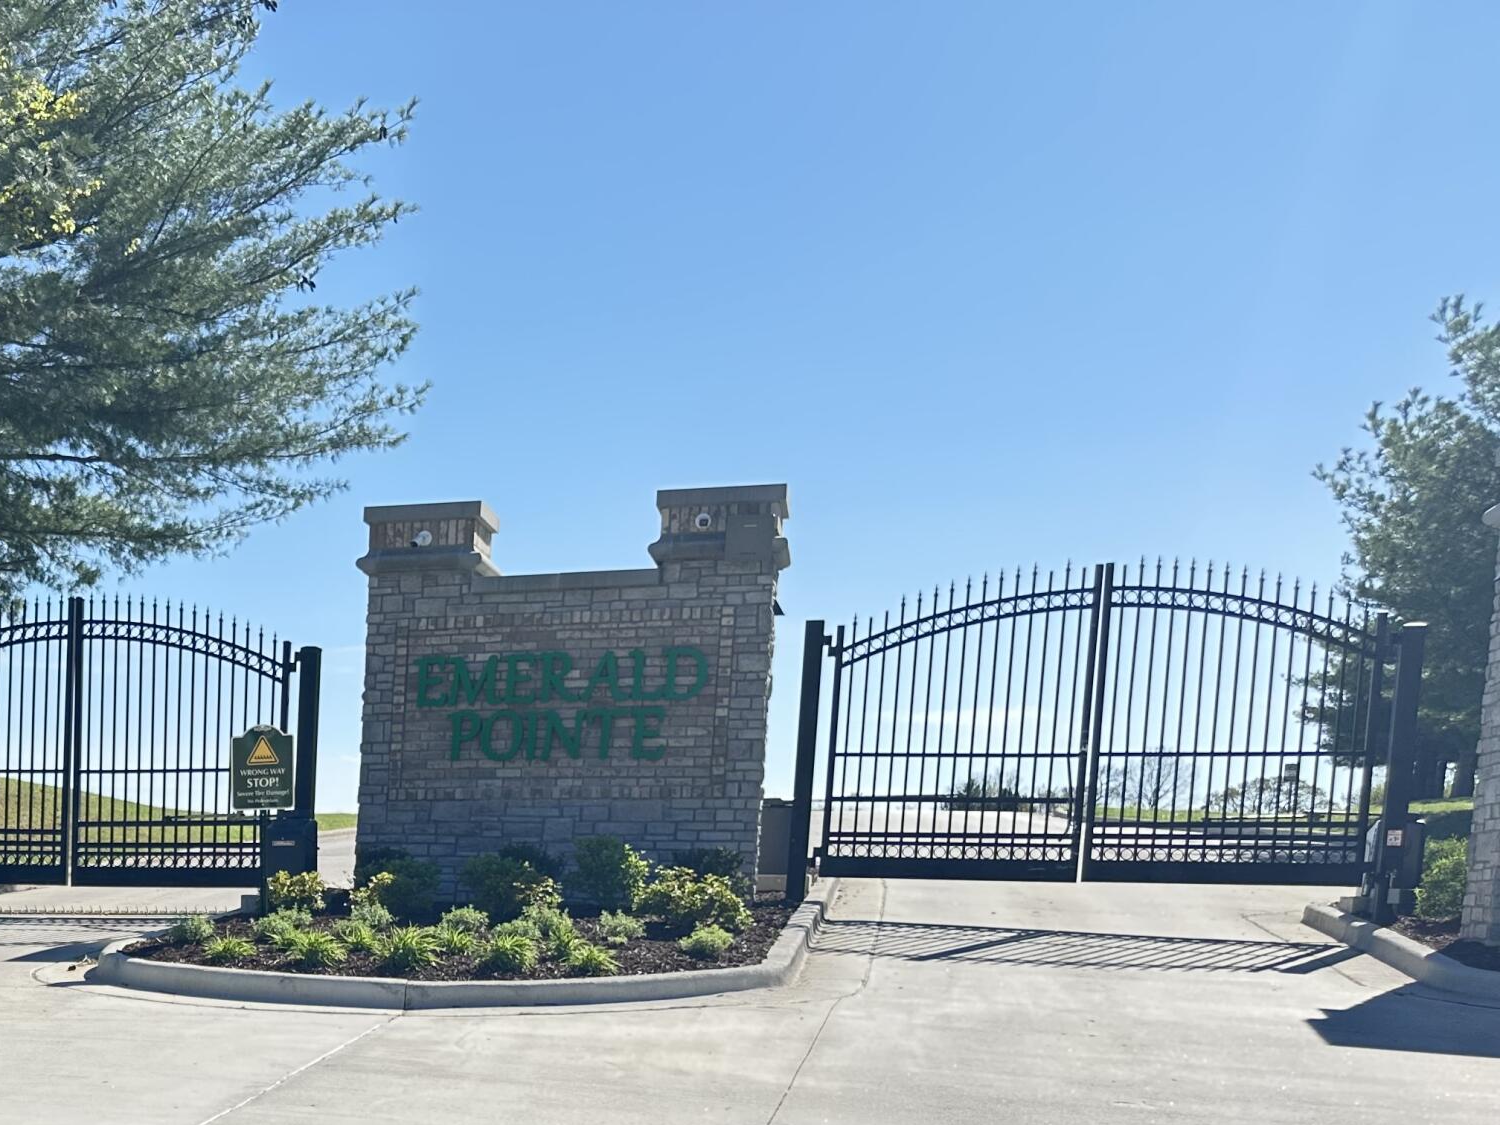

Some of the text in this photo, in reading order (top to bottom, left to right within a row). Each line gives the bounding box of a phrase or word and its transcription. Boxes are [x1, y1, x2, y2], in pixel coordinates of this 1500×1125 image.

[414, 647, 710, 708] EMERALD
[449, 708, 668, 762] POINTE
[240, 767, 286, 777] WRONG WAY
[246, 777, 280, 788] STOP!
